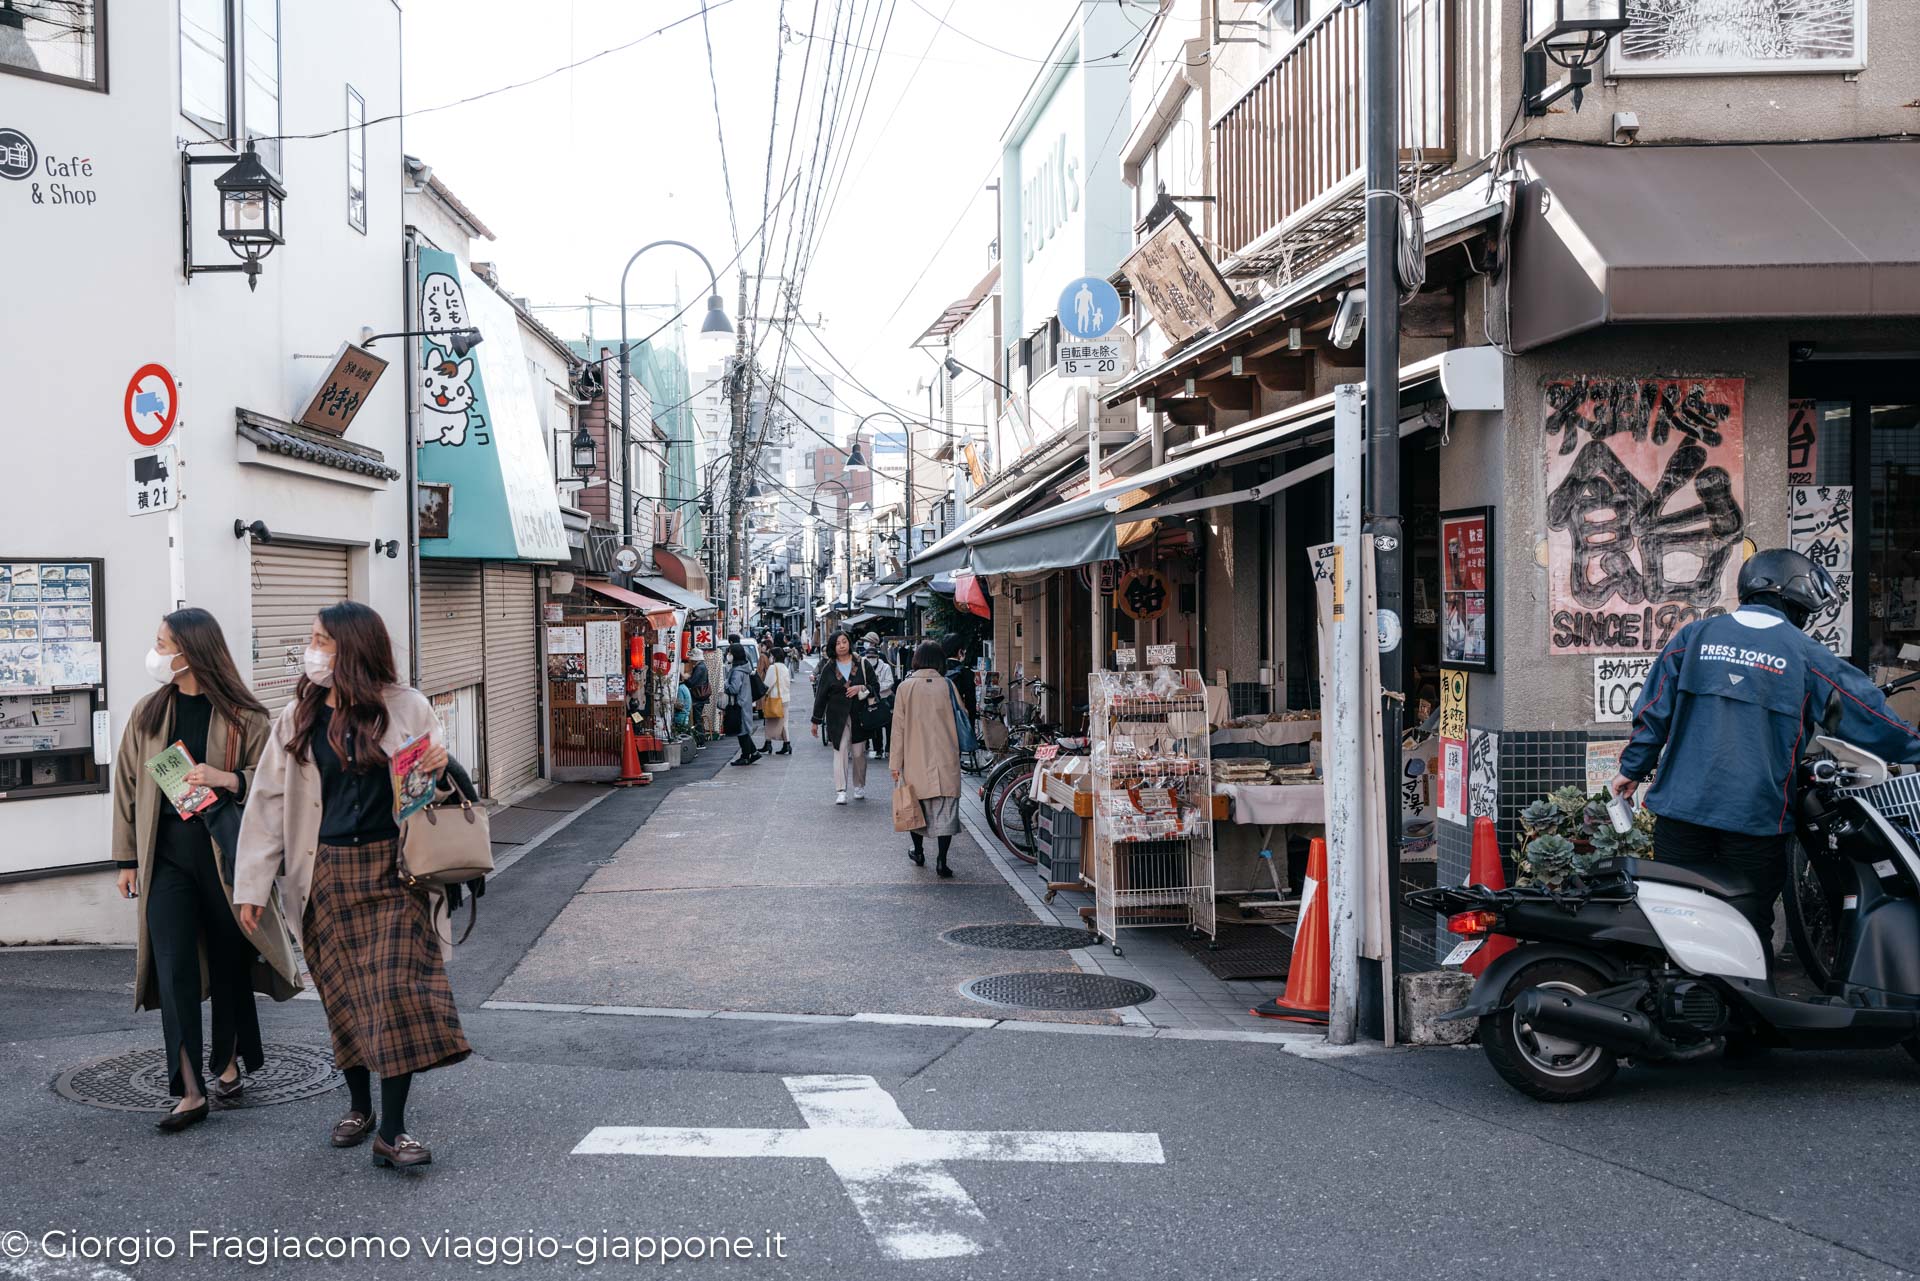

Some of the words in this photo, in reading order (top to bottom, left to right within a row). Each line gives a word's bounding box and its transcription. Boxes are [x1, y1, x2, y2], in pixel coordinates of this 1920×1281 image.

[45, 155, 93, 177] Café
[31, 182, 45, 205] &
[50, 183, 97, 206] Shop
[1061, 345, 1118, 359] 自転車を除く
[1064, 360, 1077, 373] 15
[1098, 359, 1115, 372] 20
[1789, 471, 1812, 484] 1922
[1553, 609, 1641, 648] SINCE
[1700, 643, 1737, 658] PRESS
[1739, 648, 1787, 670] TOKYO
[1651, 905, 1696, 917] GEAR
